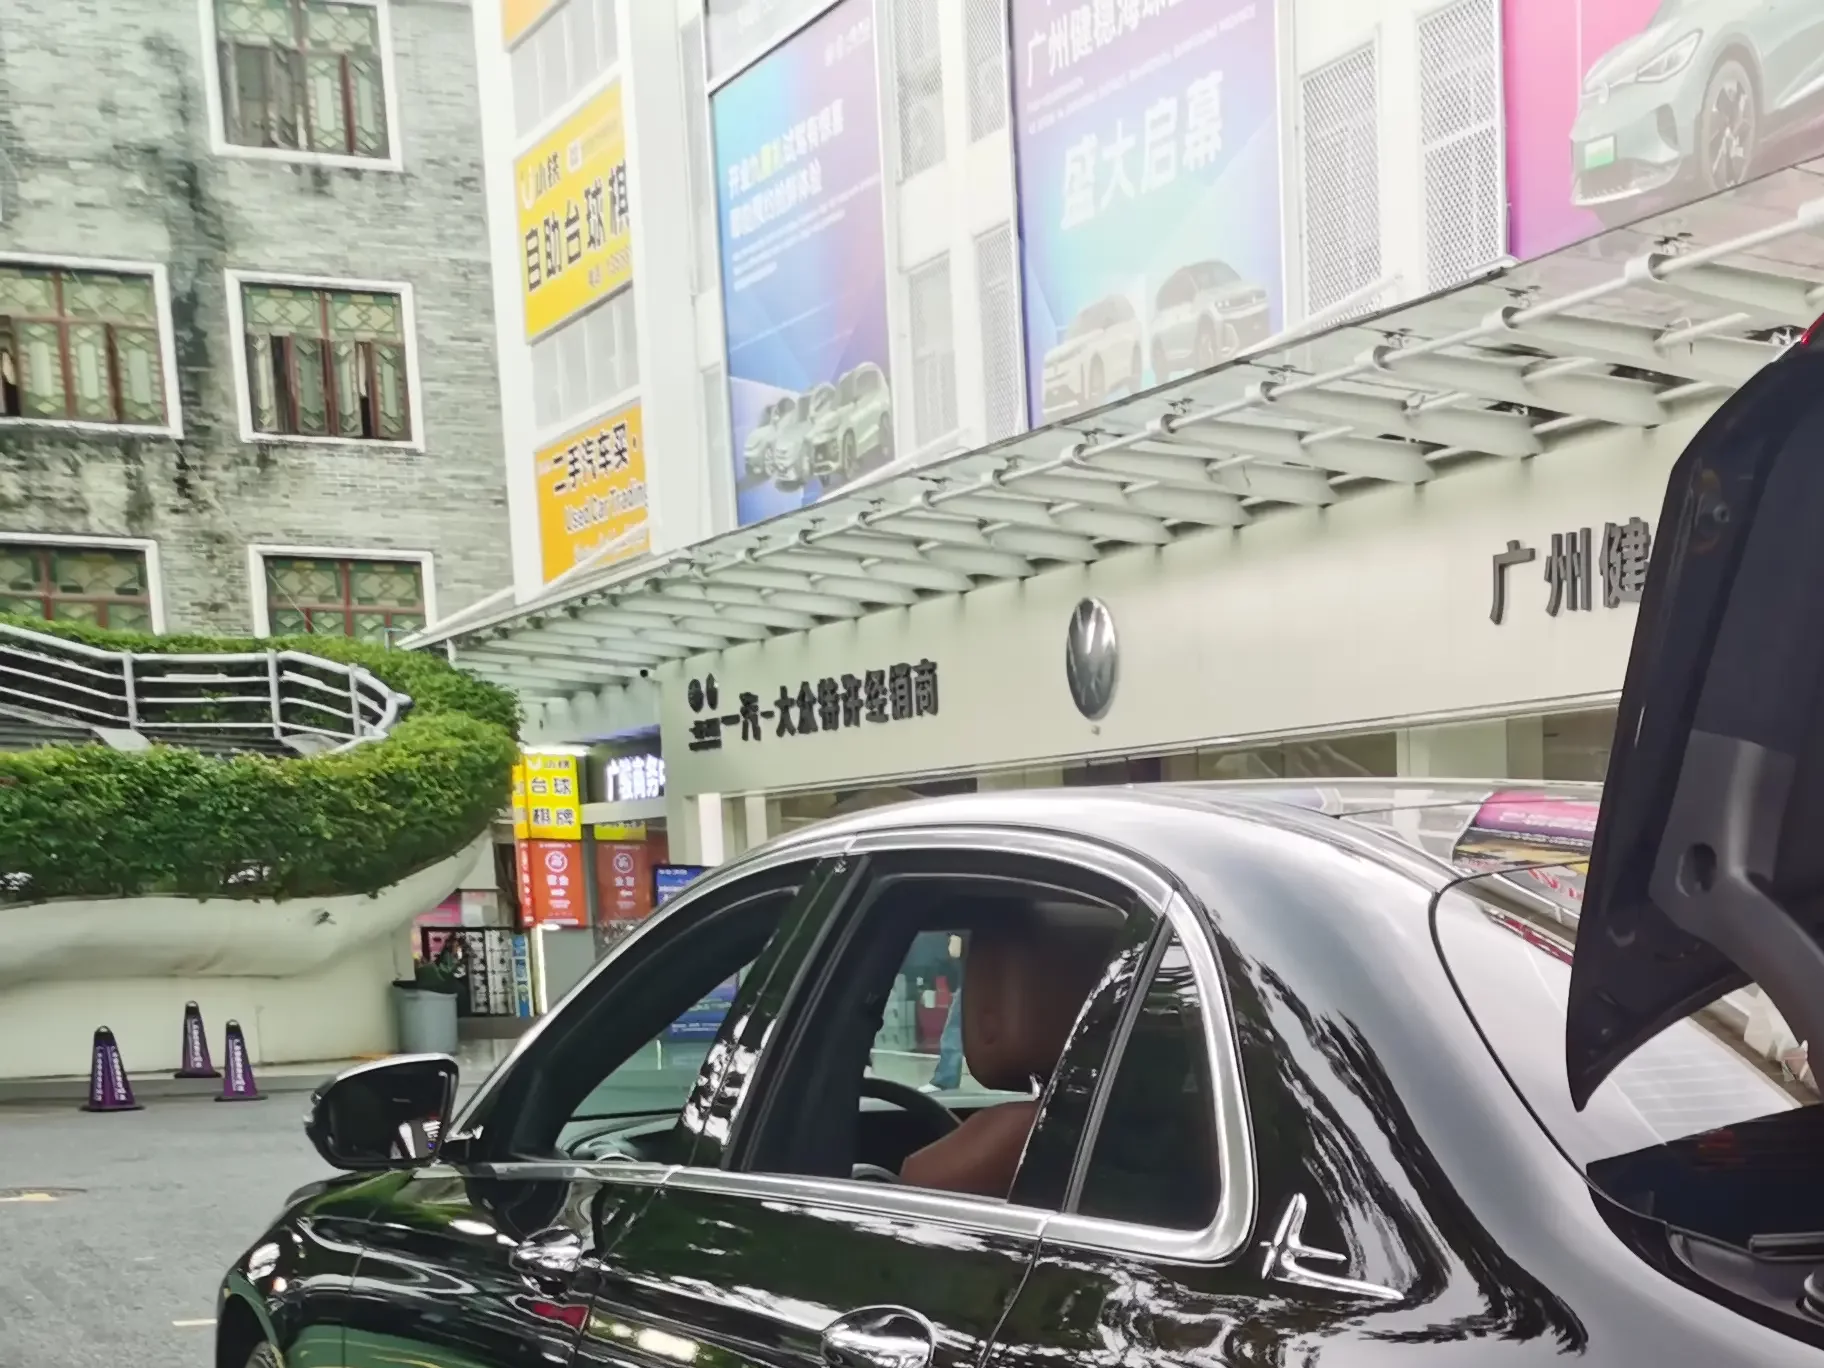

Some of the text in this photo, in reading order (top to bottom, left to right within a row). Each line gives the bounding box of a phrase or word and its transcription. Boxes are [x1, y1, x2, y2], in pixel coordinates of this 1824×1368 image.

[1060, 69, 1225, 231] 盛大启幕
[553, 422, 638, 492] 二手汽车买
[1489, 516, 1652, 626] 广州健
[531, 776, 572, 796] 台球
[533, 807, 576, 827] 棋牌
